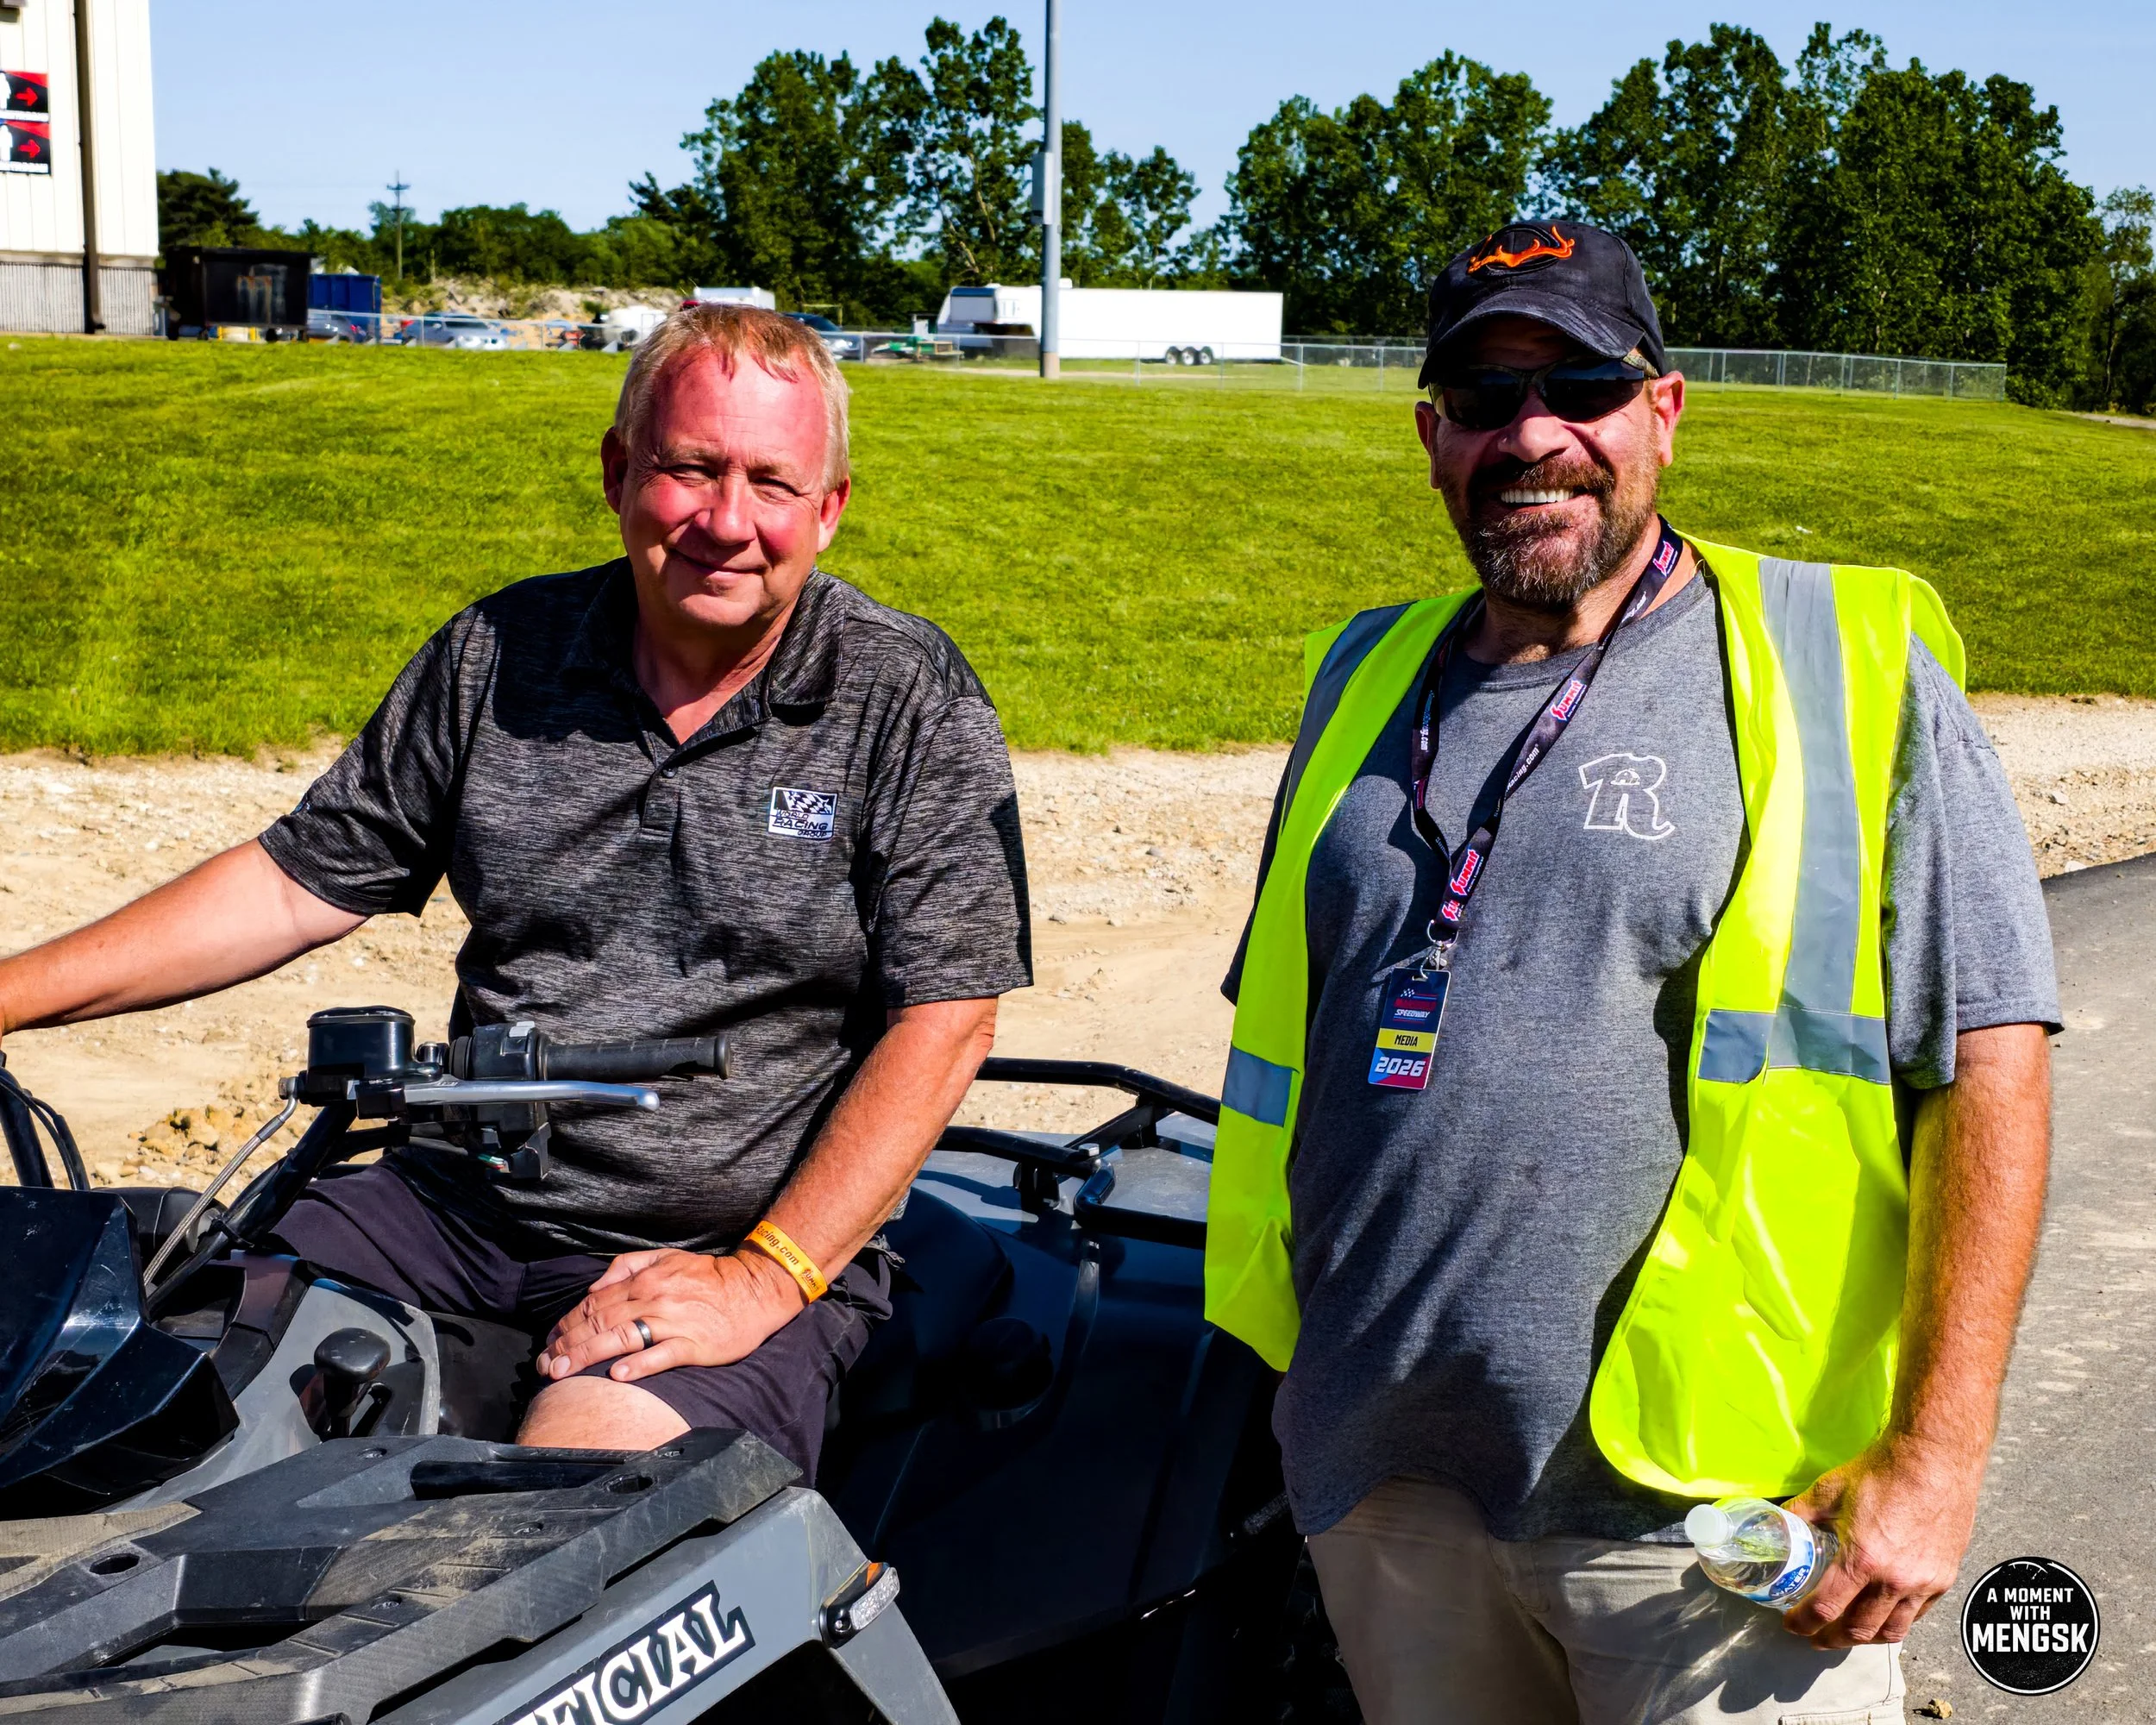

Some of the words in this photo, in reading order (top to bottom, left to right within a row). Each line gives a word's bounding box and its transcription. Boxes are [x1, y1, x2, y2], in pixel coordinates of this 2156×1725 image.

[1550, 680, 1584, 721] SUMMIT
[774, 818, 828, 830] RACING
[1451, 850, 1479, 895] SUMMIT
[1395, 1009, 1431, 1019] SPEEDWAY
[1394, 1034, 1419, 1047] MEDIA
[1375, 1057, 1426, 1077] 2026
[512, 1593, 747, 1725] FICIAL
